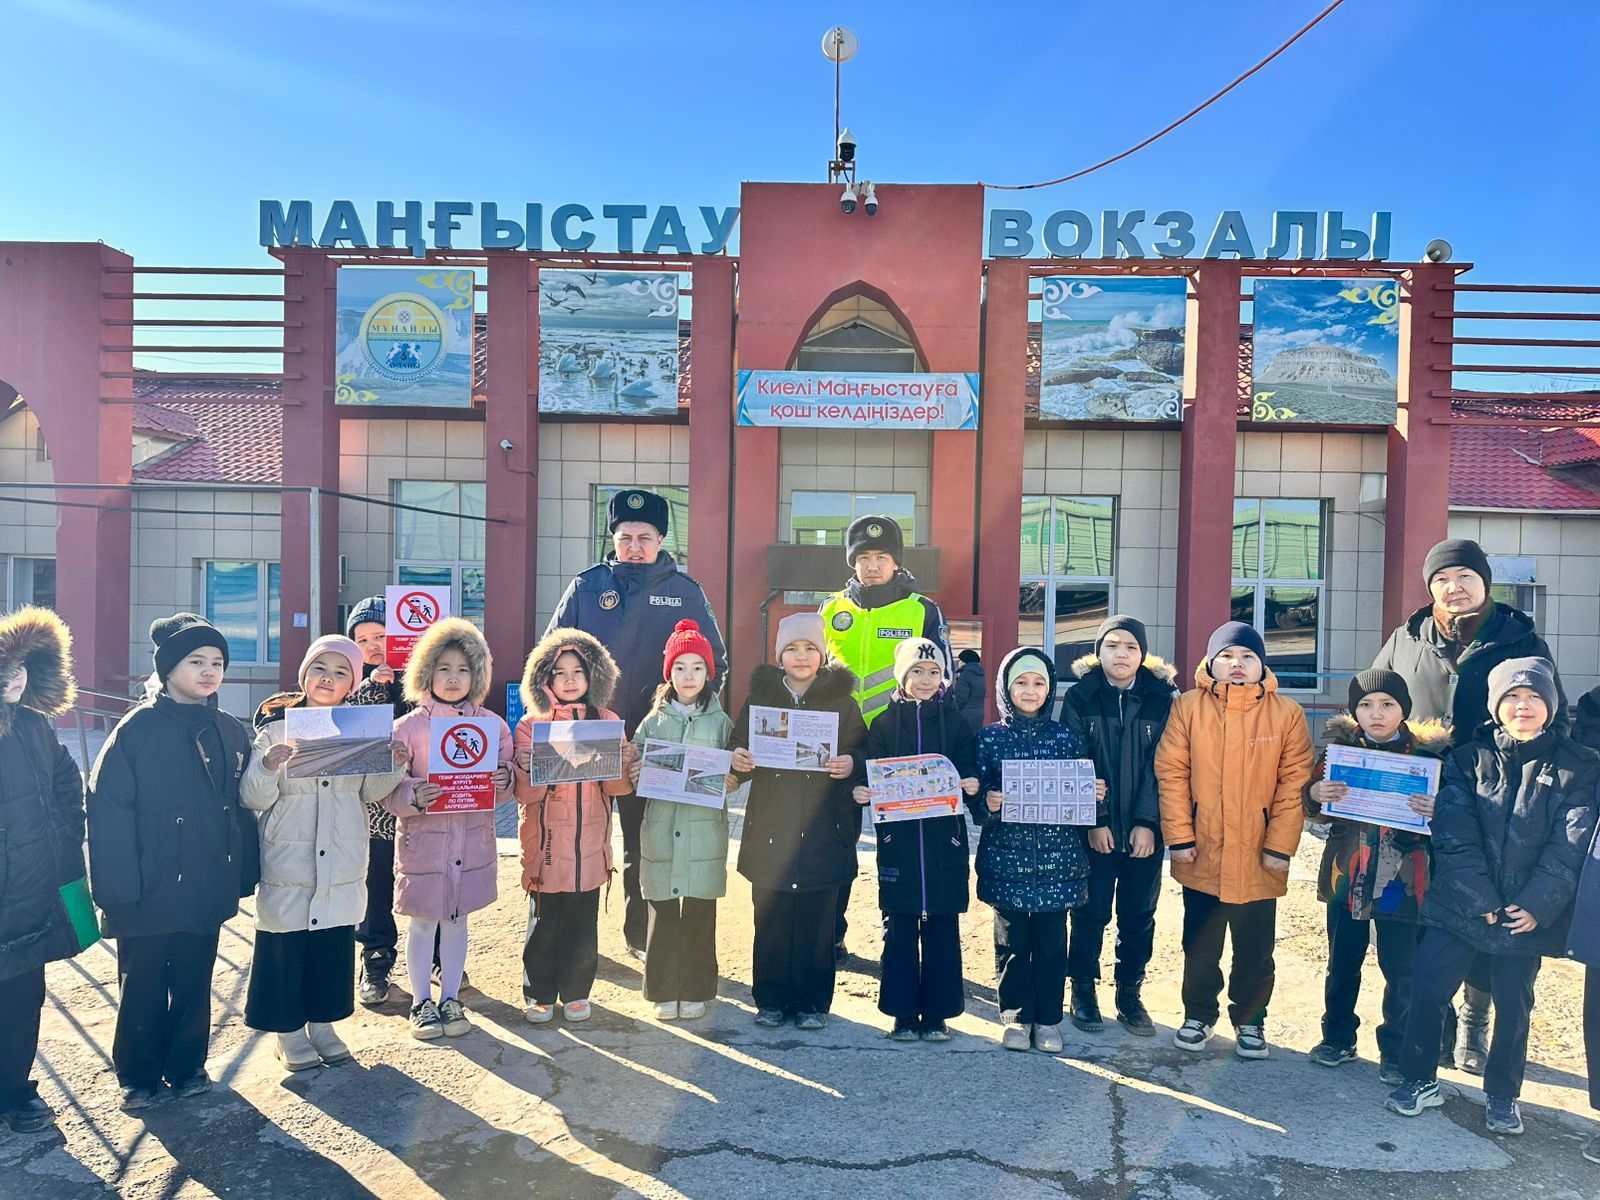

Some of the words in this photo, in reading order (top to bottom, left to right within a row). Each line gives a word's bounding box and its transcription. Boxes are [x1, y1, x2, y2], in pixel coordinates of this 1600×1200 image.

[259, 200, 740, 257] МАҢҒЫСТАУ
[988, 209, 1392, 260] ВОКЗАЛЫ
[757, 378, 812, 396] Киелі
[817, 379, 958, 401] Маңғыстауға
[770, 403, 812, 420] қош
[817, 402, 945, 424] келдіңіздер!
[880, 630, 909, 638] POLISIA
[918, 643, 936, 660] NY
